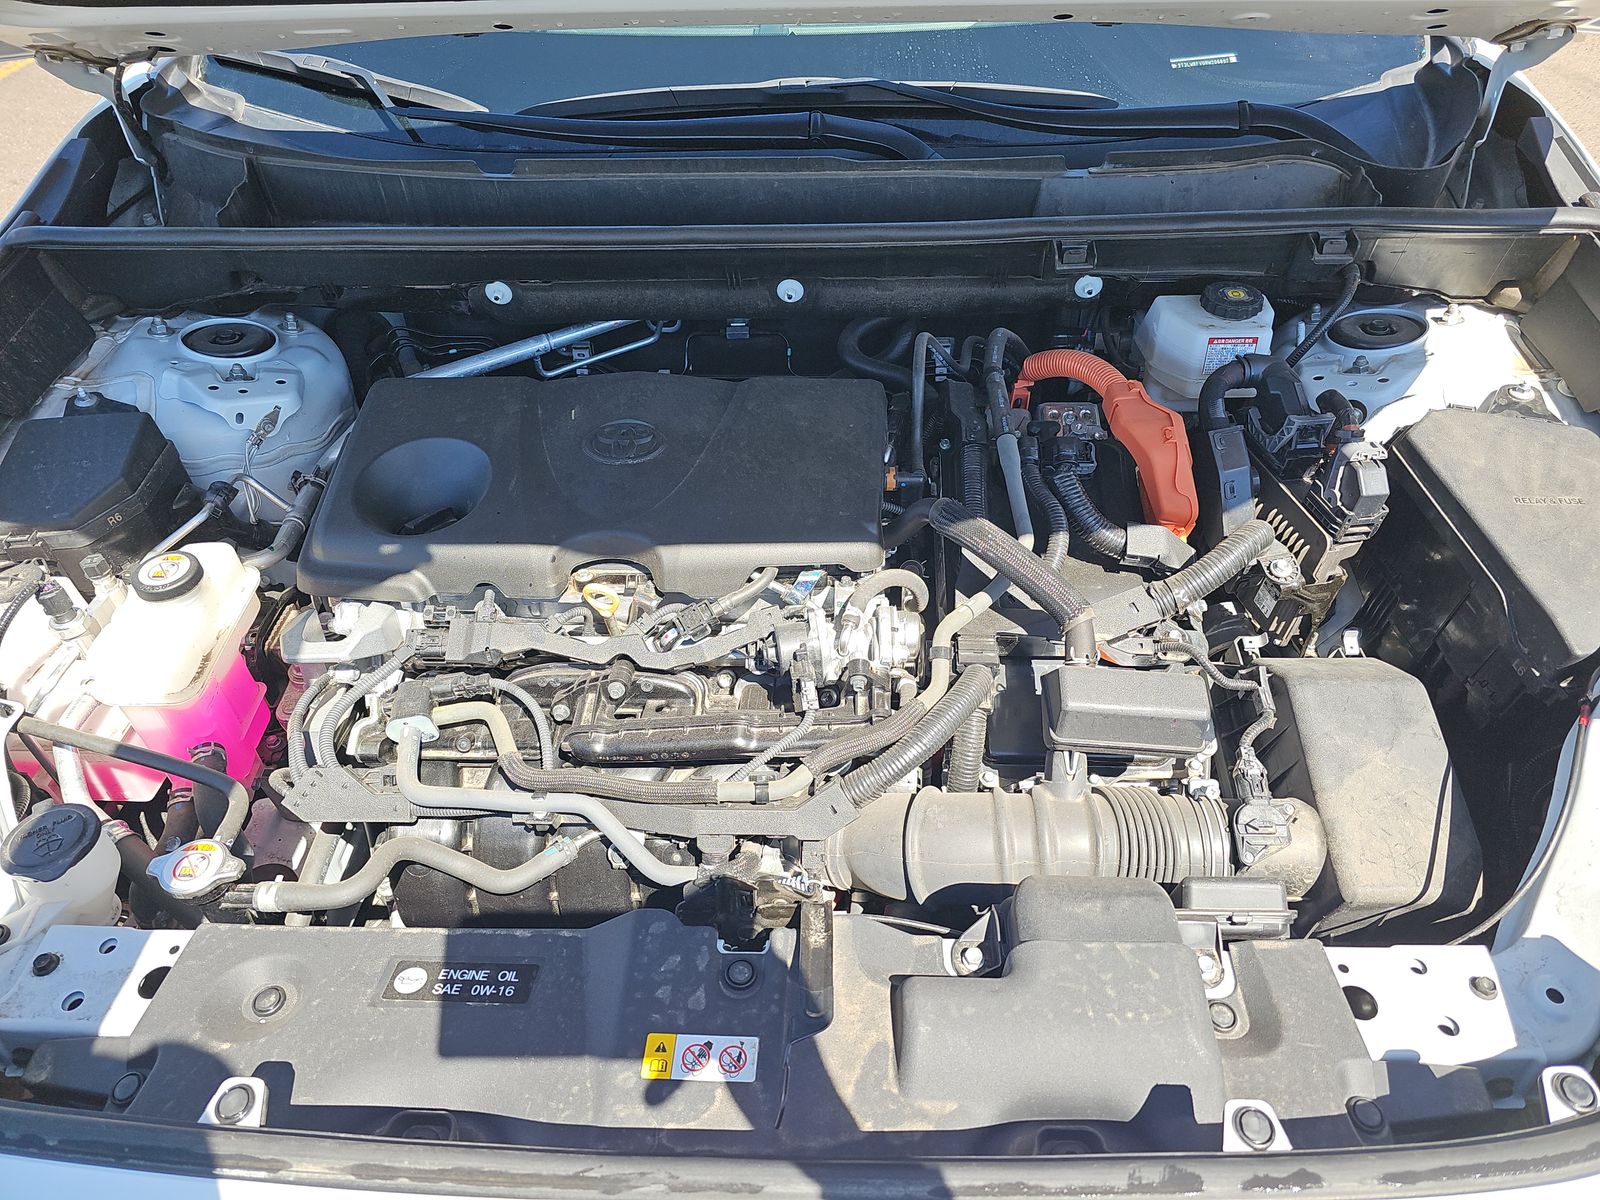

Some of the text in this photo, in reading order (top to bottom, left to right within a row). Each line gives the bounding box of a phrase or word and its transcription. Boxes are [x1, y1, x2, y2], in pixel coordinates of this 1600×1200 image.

[1514, 497, 1586, 505] RELAY & FUSE
[107, 512, 123, 527] R6
[52, 814, 73, 827] FLUID
[437, 969, 519, 982] ENGINE OIL
[431, 983, 515, 997] SAE 0W-16
